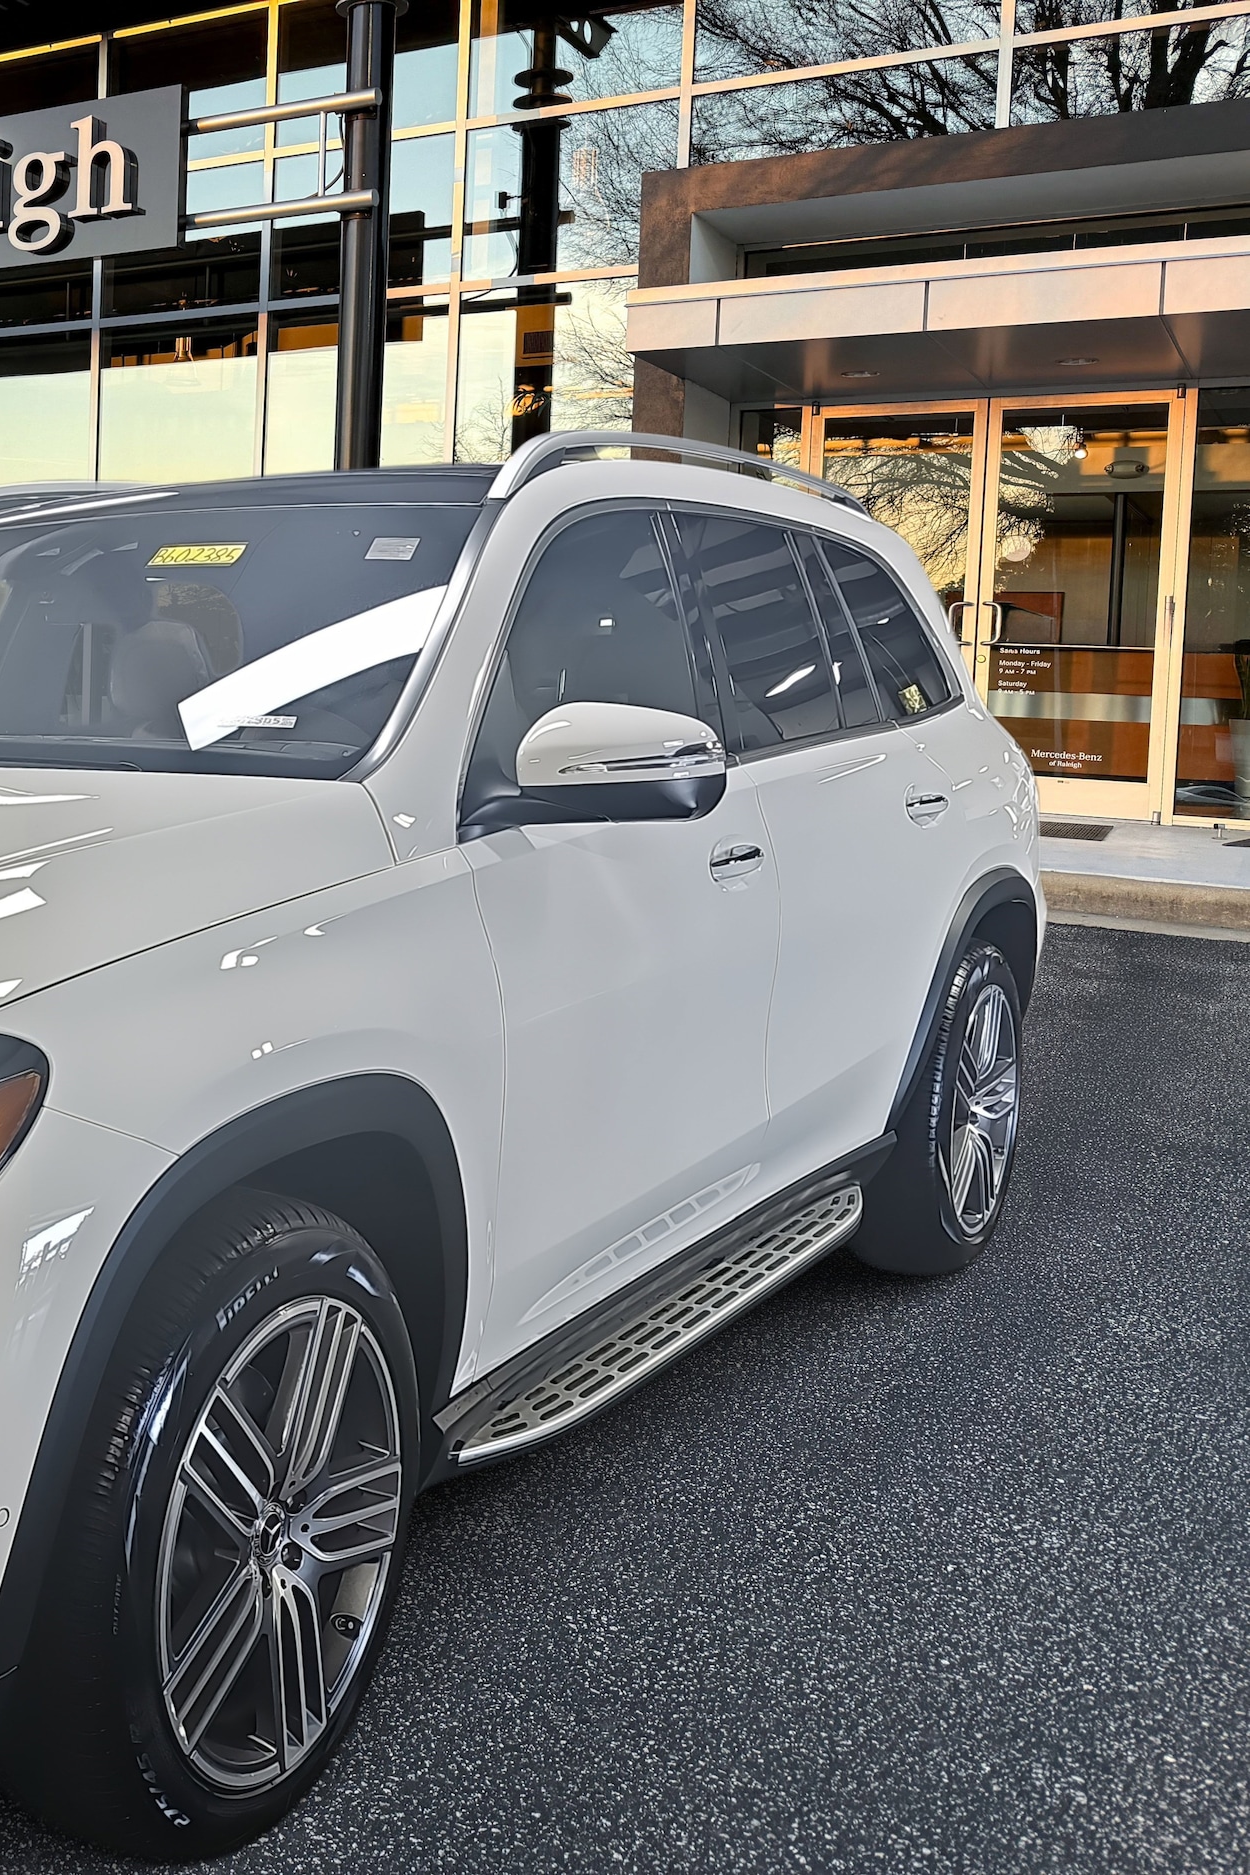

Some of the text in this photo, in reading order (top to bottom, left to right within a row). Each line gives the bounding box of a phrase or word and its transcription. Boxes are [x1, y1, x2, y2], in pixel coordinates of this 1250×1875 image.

[999, 660, 1025, 668] Monday
[1030, 660, 1051, 669] Friday
[997, 680, 1027, 688] Saturday
[1030, 749, 1103, 762] Mercedes-Benz
